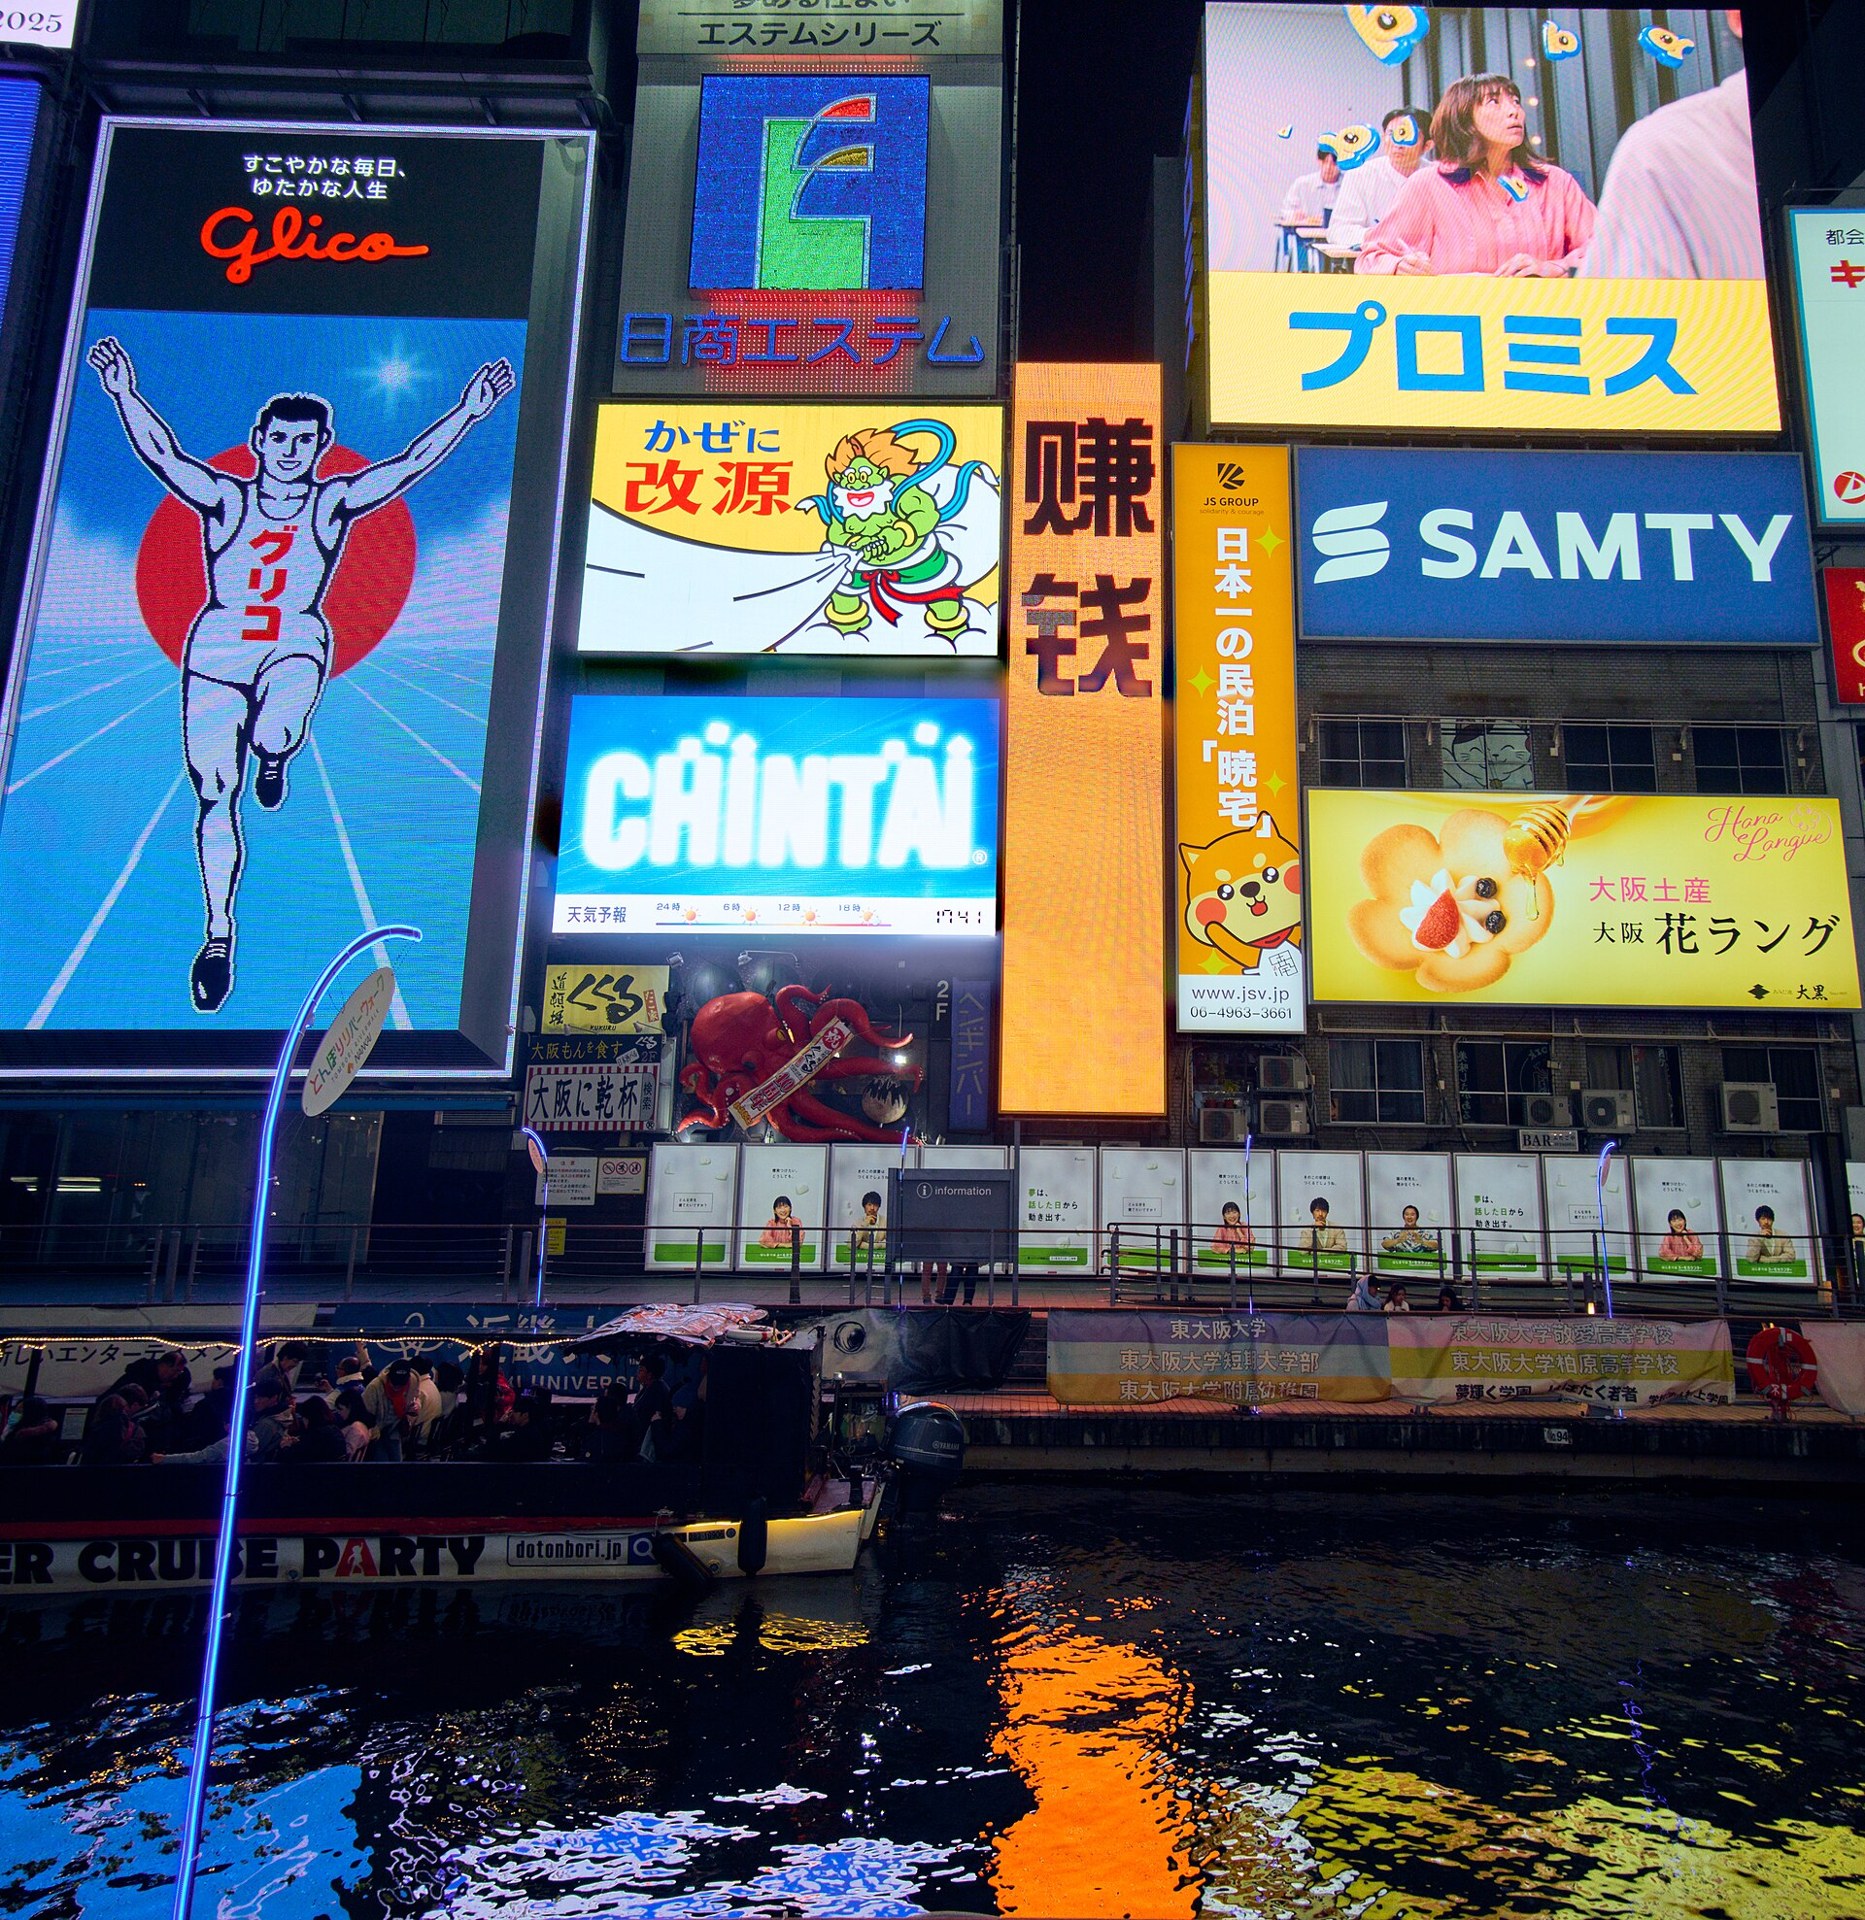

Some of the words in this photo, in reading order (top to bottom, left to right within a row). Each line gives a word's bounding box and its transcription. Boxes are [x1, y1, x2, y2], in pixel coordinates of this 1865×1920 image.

[0, 10, 63, 33] 025
[697, 21, 943, 47] エステムシリーズ
[243, 155, 407, 179] すこやかな毎日、
[252, 178, 389, 201] ゆたかな人生
[200, 206, 430, 285] Glico
[620, 310, 986, 367] 日商エステム
[1289, 299, 1698, 397] プロミス
[644, 420, 781, 454] かぜに
[624, 460, 795, 517] 改源
[1203, 497, 1217, 506] JS
[1219, 497, 1259, 507] GROUP
[1418, 507, 1794, 583] SAMTY
[242, 525, 299, 642] グリコ
[1704, 805, 1784, 843] Hana
[1733, 827, 1829, 862] Langue
[1588, 875, 1712, 904] 大阪土産
[567, 906, 627, 924] 天気予報
[1593, 921, 1645, 944] 大阪
[1654, 912, 1841, 957] 花ラング
[935, 980, 950, 1021] 2F
[1192, 986, 1290, 1004] www.jsv.jp
[1796, 984, 1829, 1001] 大黒
[1190, 1006, 1292, 1019] 06-4963-3661
[530, 1040, 623, 1060] 大阪もんを食す
[530, 1075, 638, 1120] 大阪に乾杯
[1522, 1134, 1552, 1147] BAR
[934, 1186, 992, 1197] information
[1028, 1201, 1078, 1210] 話した日から
[1028, 1213, 1066, 1222] 動き出す。
[1474, 1207, 1524, 1217] 話した日から
[1170, 1318, 1266, 1340] 東大阪大学
[1119, 1349, 1320, 1374] 東大阪大学短期大学部
[302, 1537, 485, 1577] PARTY
[515, 1539, 623, 1561] dotonbori.jp
